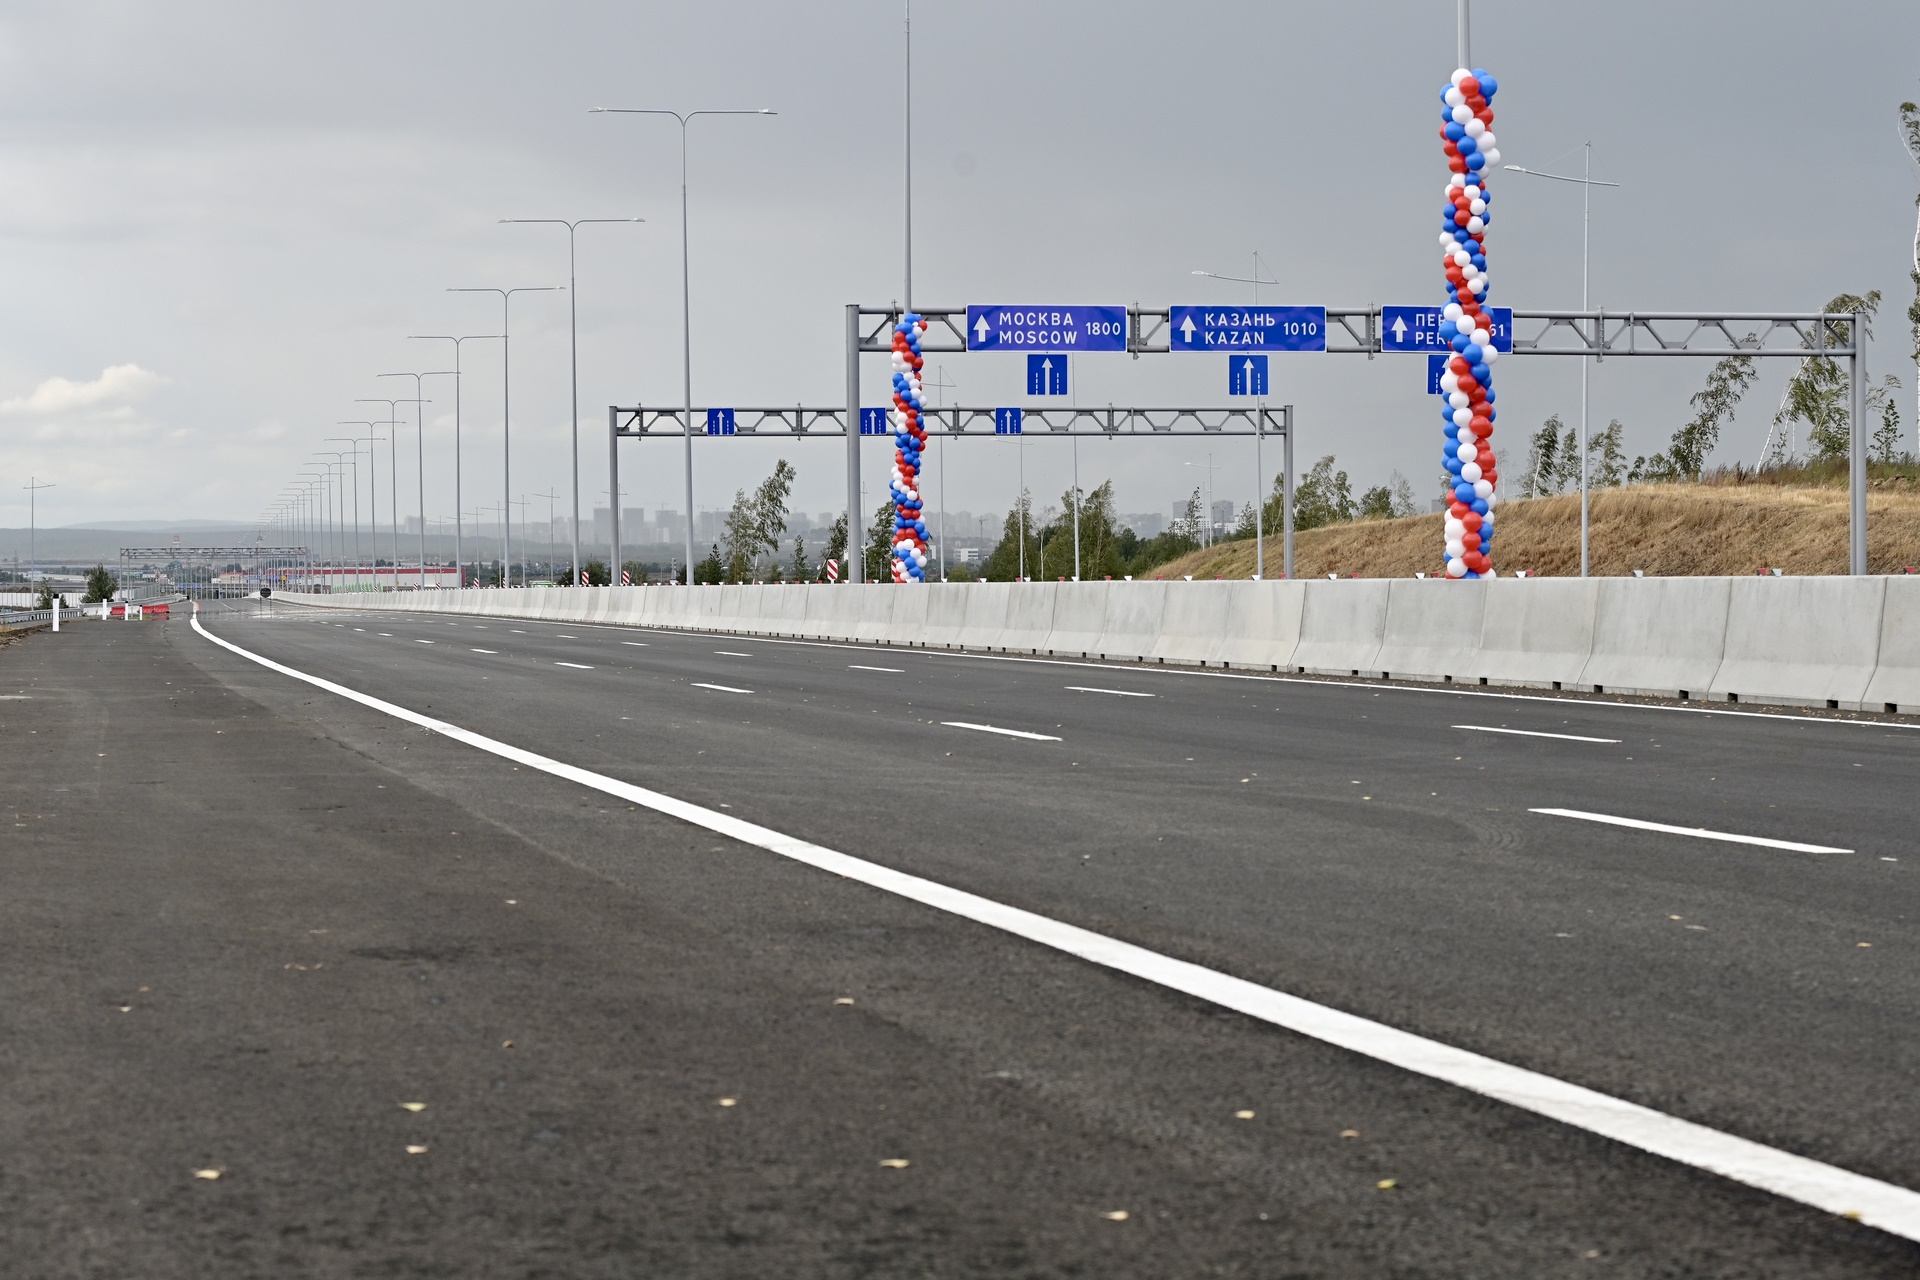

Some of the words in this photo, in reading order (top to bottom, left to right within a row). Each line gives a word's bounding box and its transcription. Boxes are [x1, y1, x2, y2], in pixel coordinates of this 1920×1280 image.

[999, 312, 1074, 326] МОСКВА
[1205, 313, 1276, 327] КАЗАНЬ
[1085, 322, 1121, 336] 1800
[1283, 322, 1317, 336] 1010
[1489, 324, 1504, 337] 61
[999, 331, 1078, 344] MOSCOW
[1205, 331, 1265, 345] KAZAN
